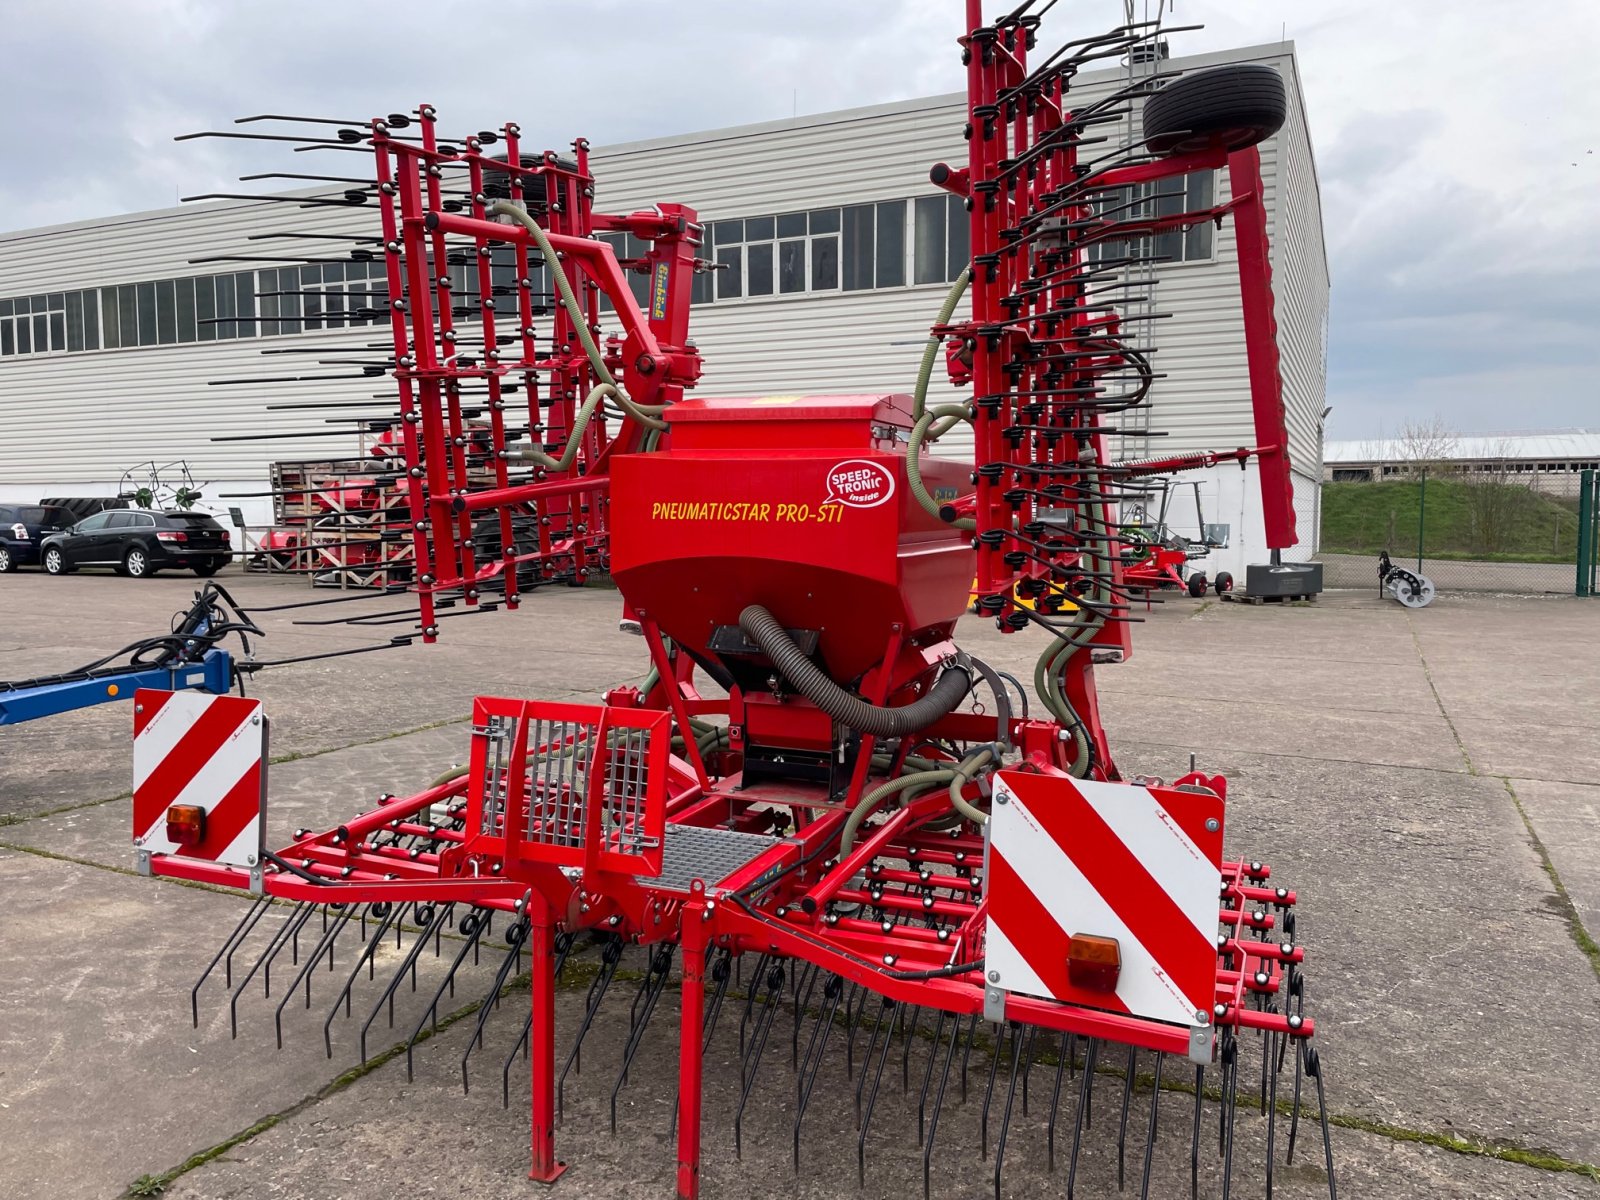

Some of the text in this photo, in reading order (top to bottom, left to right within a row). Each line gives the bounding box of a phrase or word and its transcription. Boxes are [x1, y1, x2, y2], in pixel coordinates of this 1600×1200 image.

[831, 469, 877, 486] SPEED-
[836, 476, 883, 495] TRONIC
[848, 491, 880, 503] inside
[651, 502, 845, 523] PNEUMATICSTAR PRO-STI
